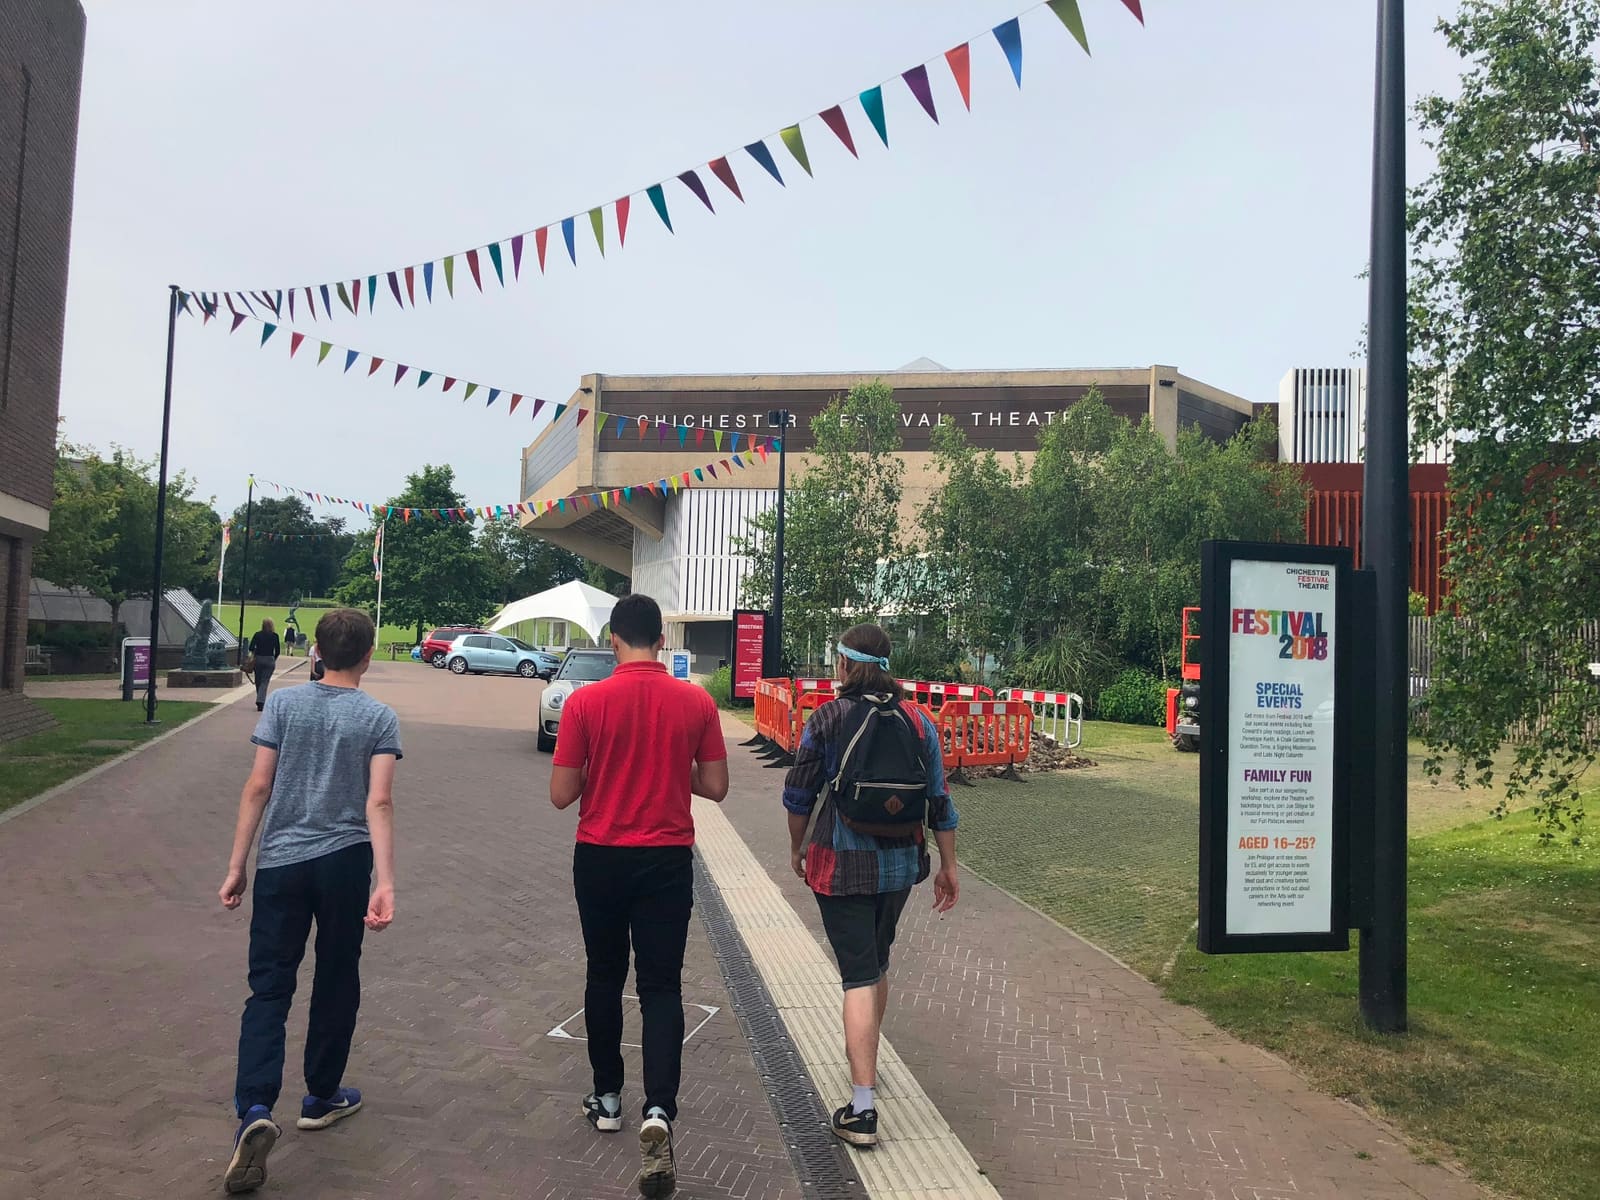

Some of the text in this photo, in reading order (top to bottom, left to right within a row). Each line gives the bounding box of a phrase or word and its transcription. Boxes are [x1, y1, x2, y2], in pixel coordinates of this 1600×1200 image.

[637, 411, 1092, 428] CHICHESTR ESVAL THEAT
[1286, 568, 1329, 576] CHICHESTER
[1232, 608, 1328, 637] FESTIVAL
[1279, 634, 1328, 661] 2018
[1256, 682, 1304, 696] SPECIAL
[1257, 695, 1302, 709] EVENTS
[1244, 769, 1312, 783] FAMILY FUN
[1238, 836, 1269, 849] AGED
